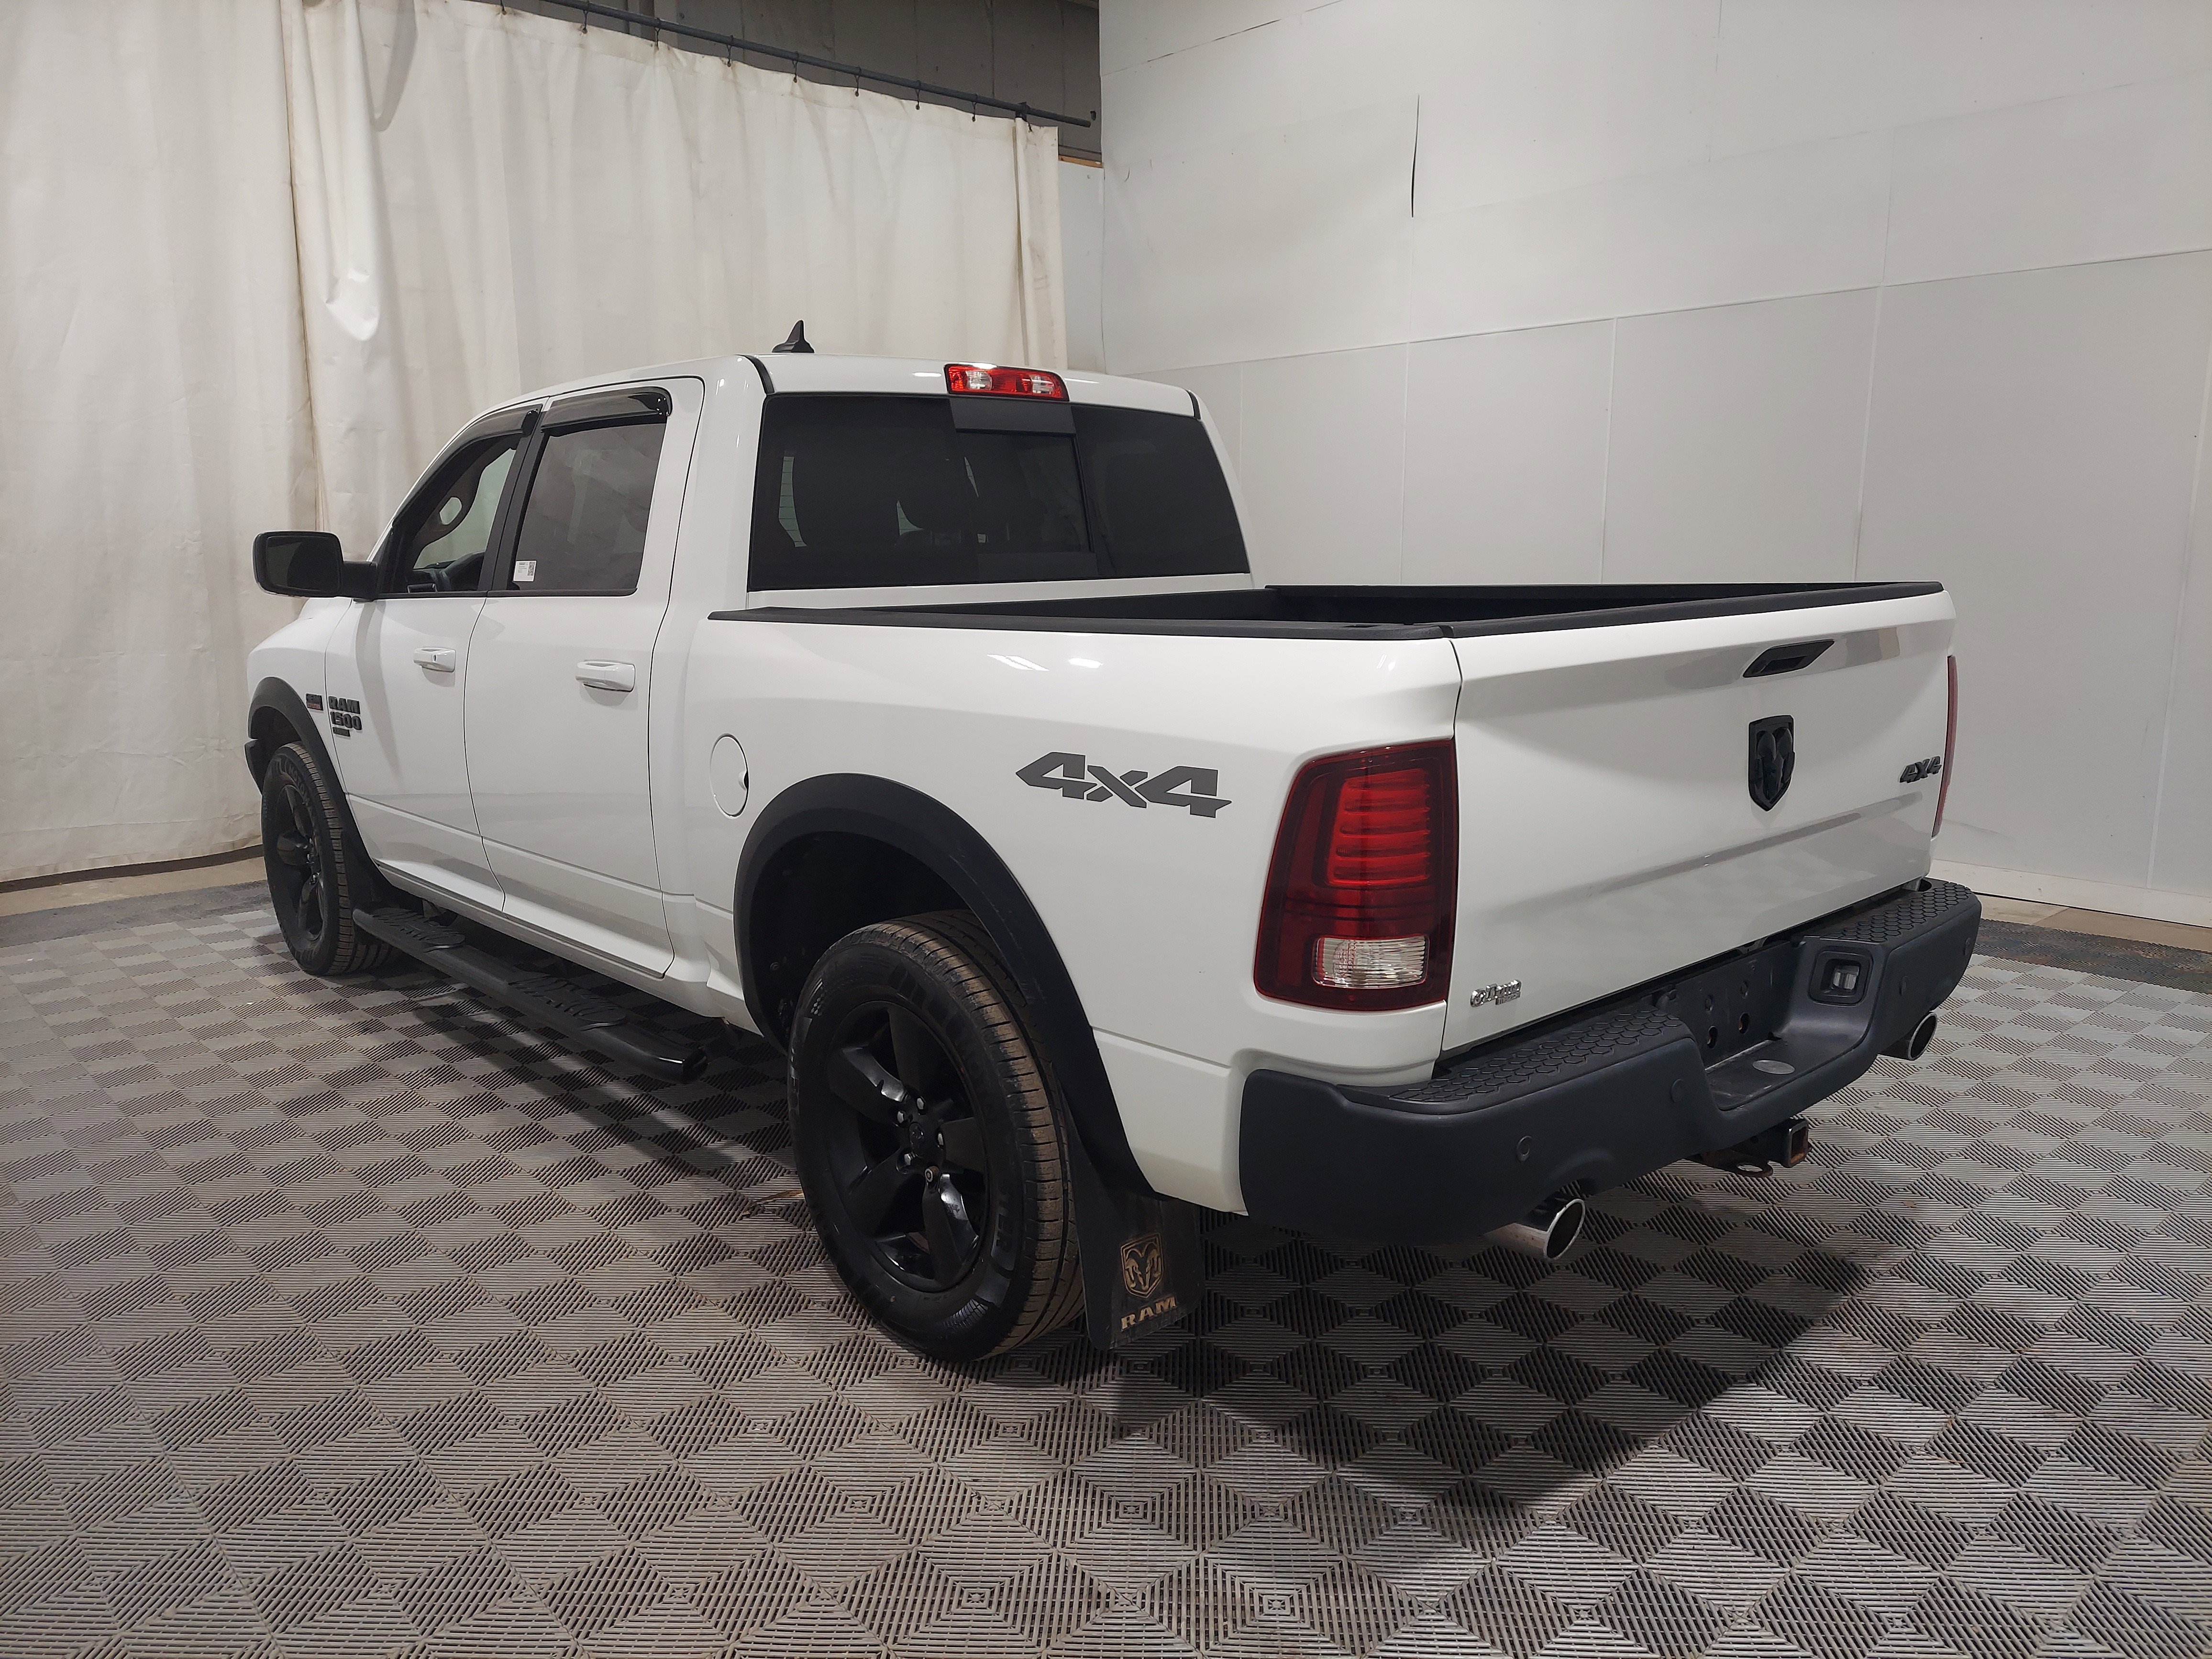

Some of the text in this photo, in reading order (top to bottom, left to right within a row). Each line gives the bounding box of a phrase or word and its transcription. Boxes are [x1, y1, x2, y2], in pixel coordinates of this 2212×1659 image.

[328, 696, 361, 714] RAM
[330, 711, 362, 730] 1500
[1015, 751, 1232, 818] 4x4
[1120, 1296, 1176, 1330] RAM
